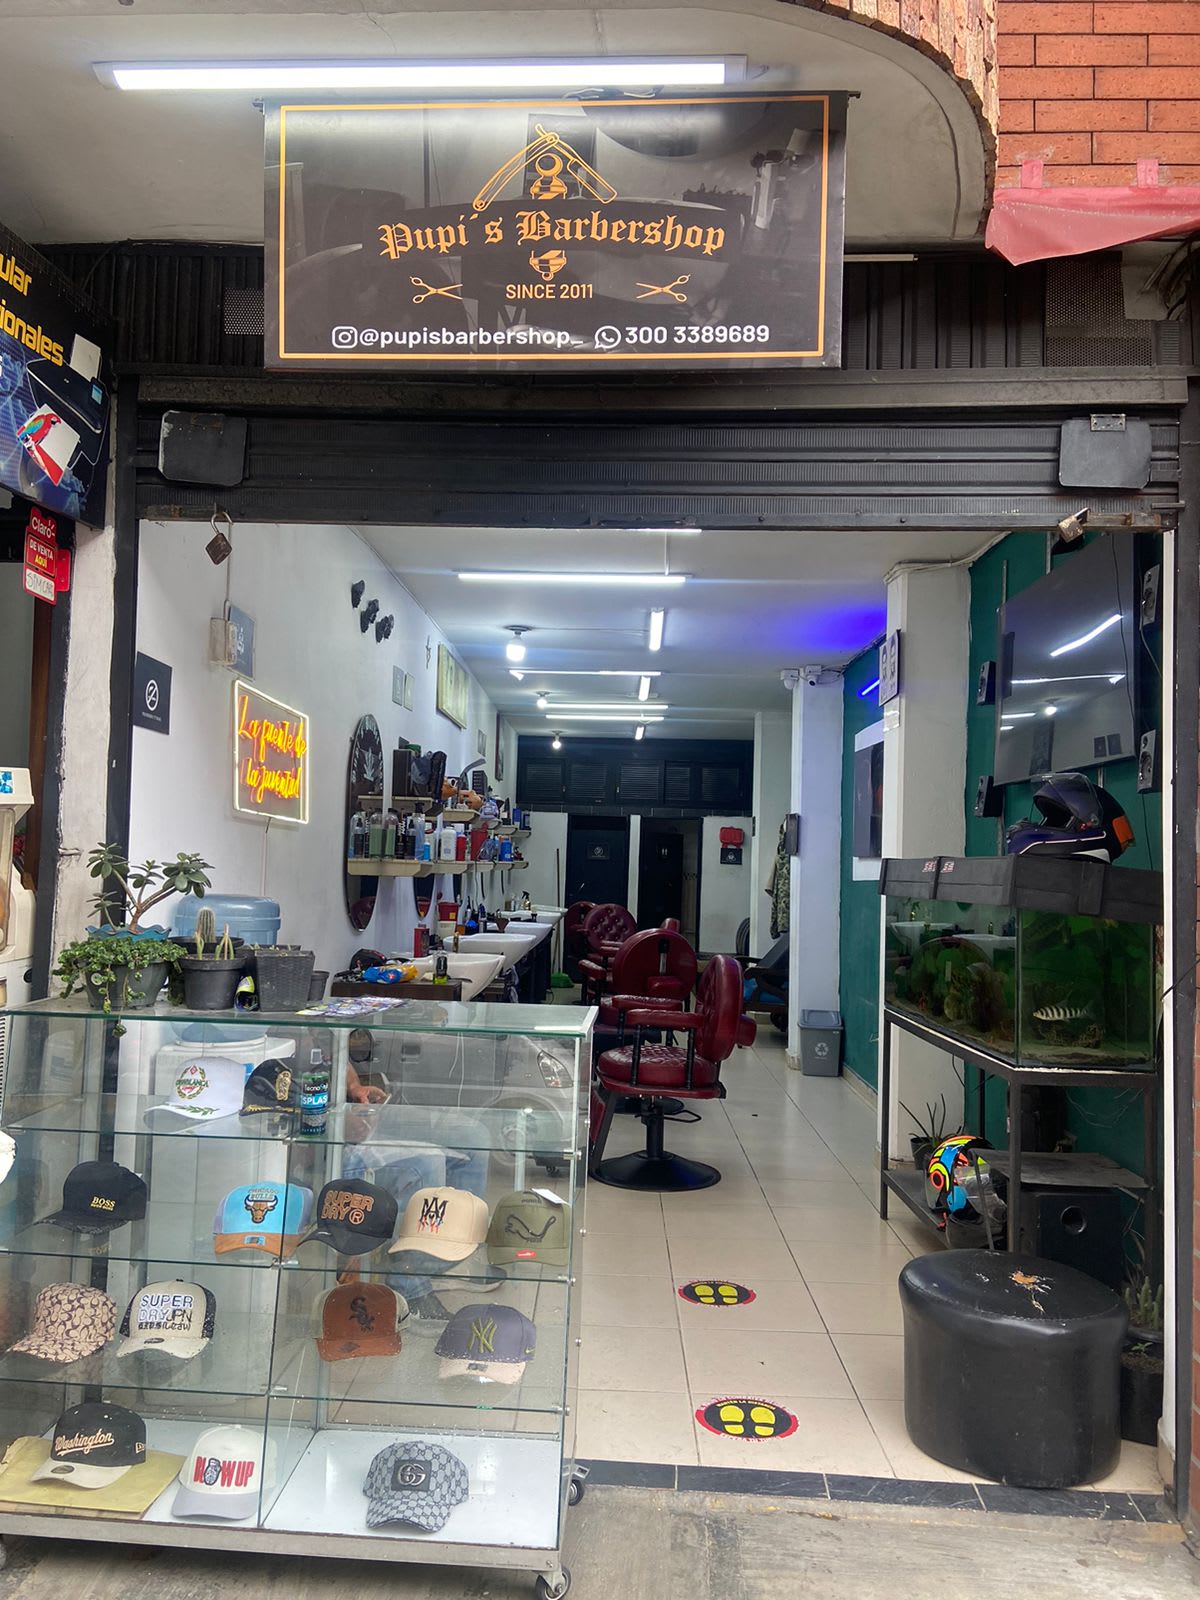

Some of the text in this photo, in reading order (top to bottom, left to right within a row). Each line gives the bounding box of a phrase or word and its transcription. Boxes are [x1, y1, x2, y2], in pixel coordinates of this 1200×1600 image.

[515, 209, 726, 256] Barbershop
[505, 283, 594, 299] SINCE 2011
[359, 324, 770, 348] @pupisbarbershop_ 300 3389689
[31, 516, 51, 538] Claro
[29, 539, 54, 561] DE VENTA
[92, 1196, 116, 1208] BOSS
[324, 1190, 375, 1212] SUPER
[321, 1204, 351, 1221] DRY
[141, 1294, 194, 1308] SUPER
[468, 1316, 497, 1354] NY
[55, 1428, 114, 1456] Washington
